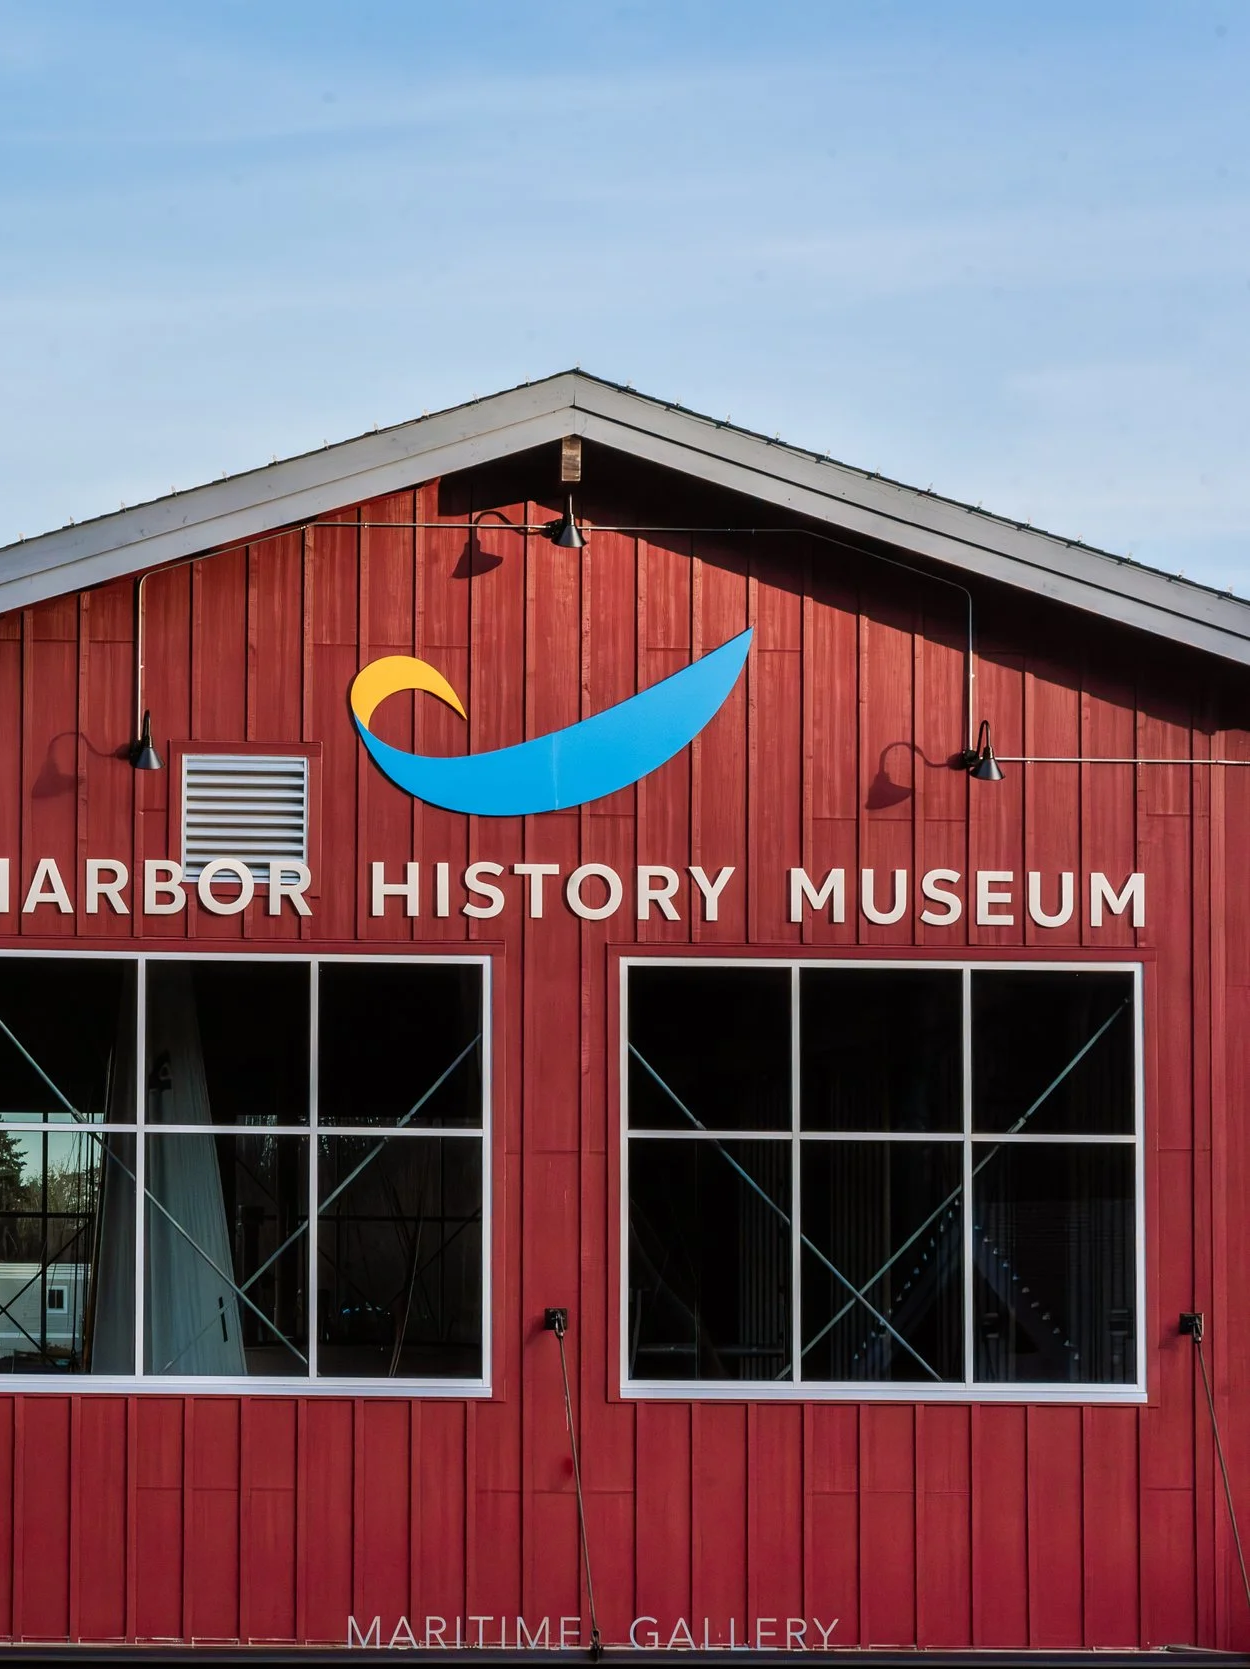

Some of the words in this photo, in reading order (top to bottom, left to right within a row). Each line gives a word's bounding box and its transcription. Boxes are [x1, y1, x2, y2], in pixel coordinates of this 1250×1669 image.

[371, 860, 735, 921] HISTORY
[790, 867, 1146, 928] MUSEUM
[347, 1615, 582, 1650] MARITIME
[629, 1616, 840, 1651] GALLERY
